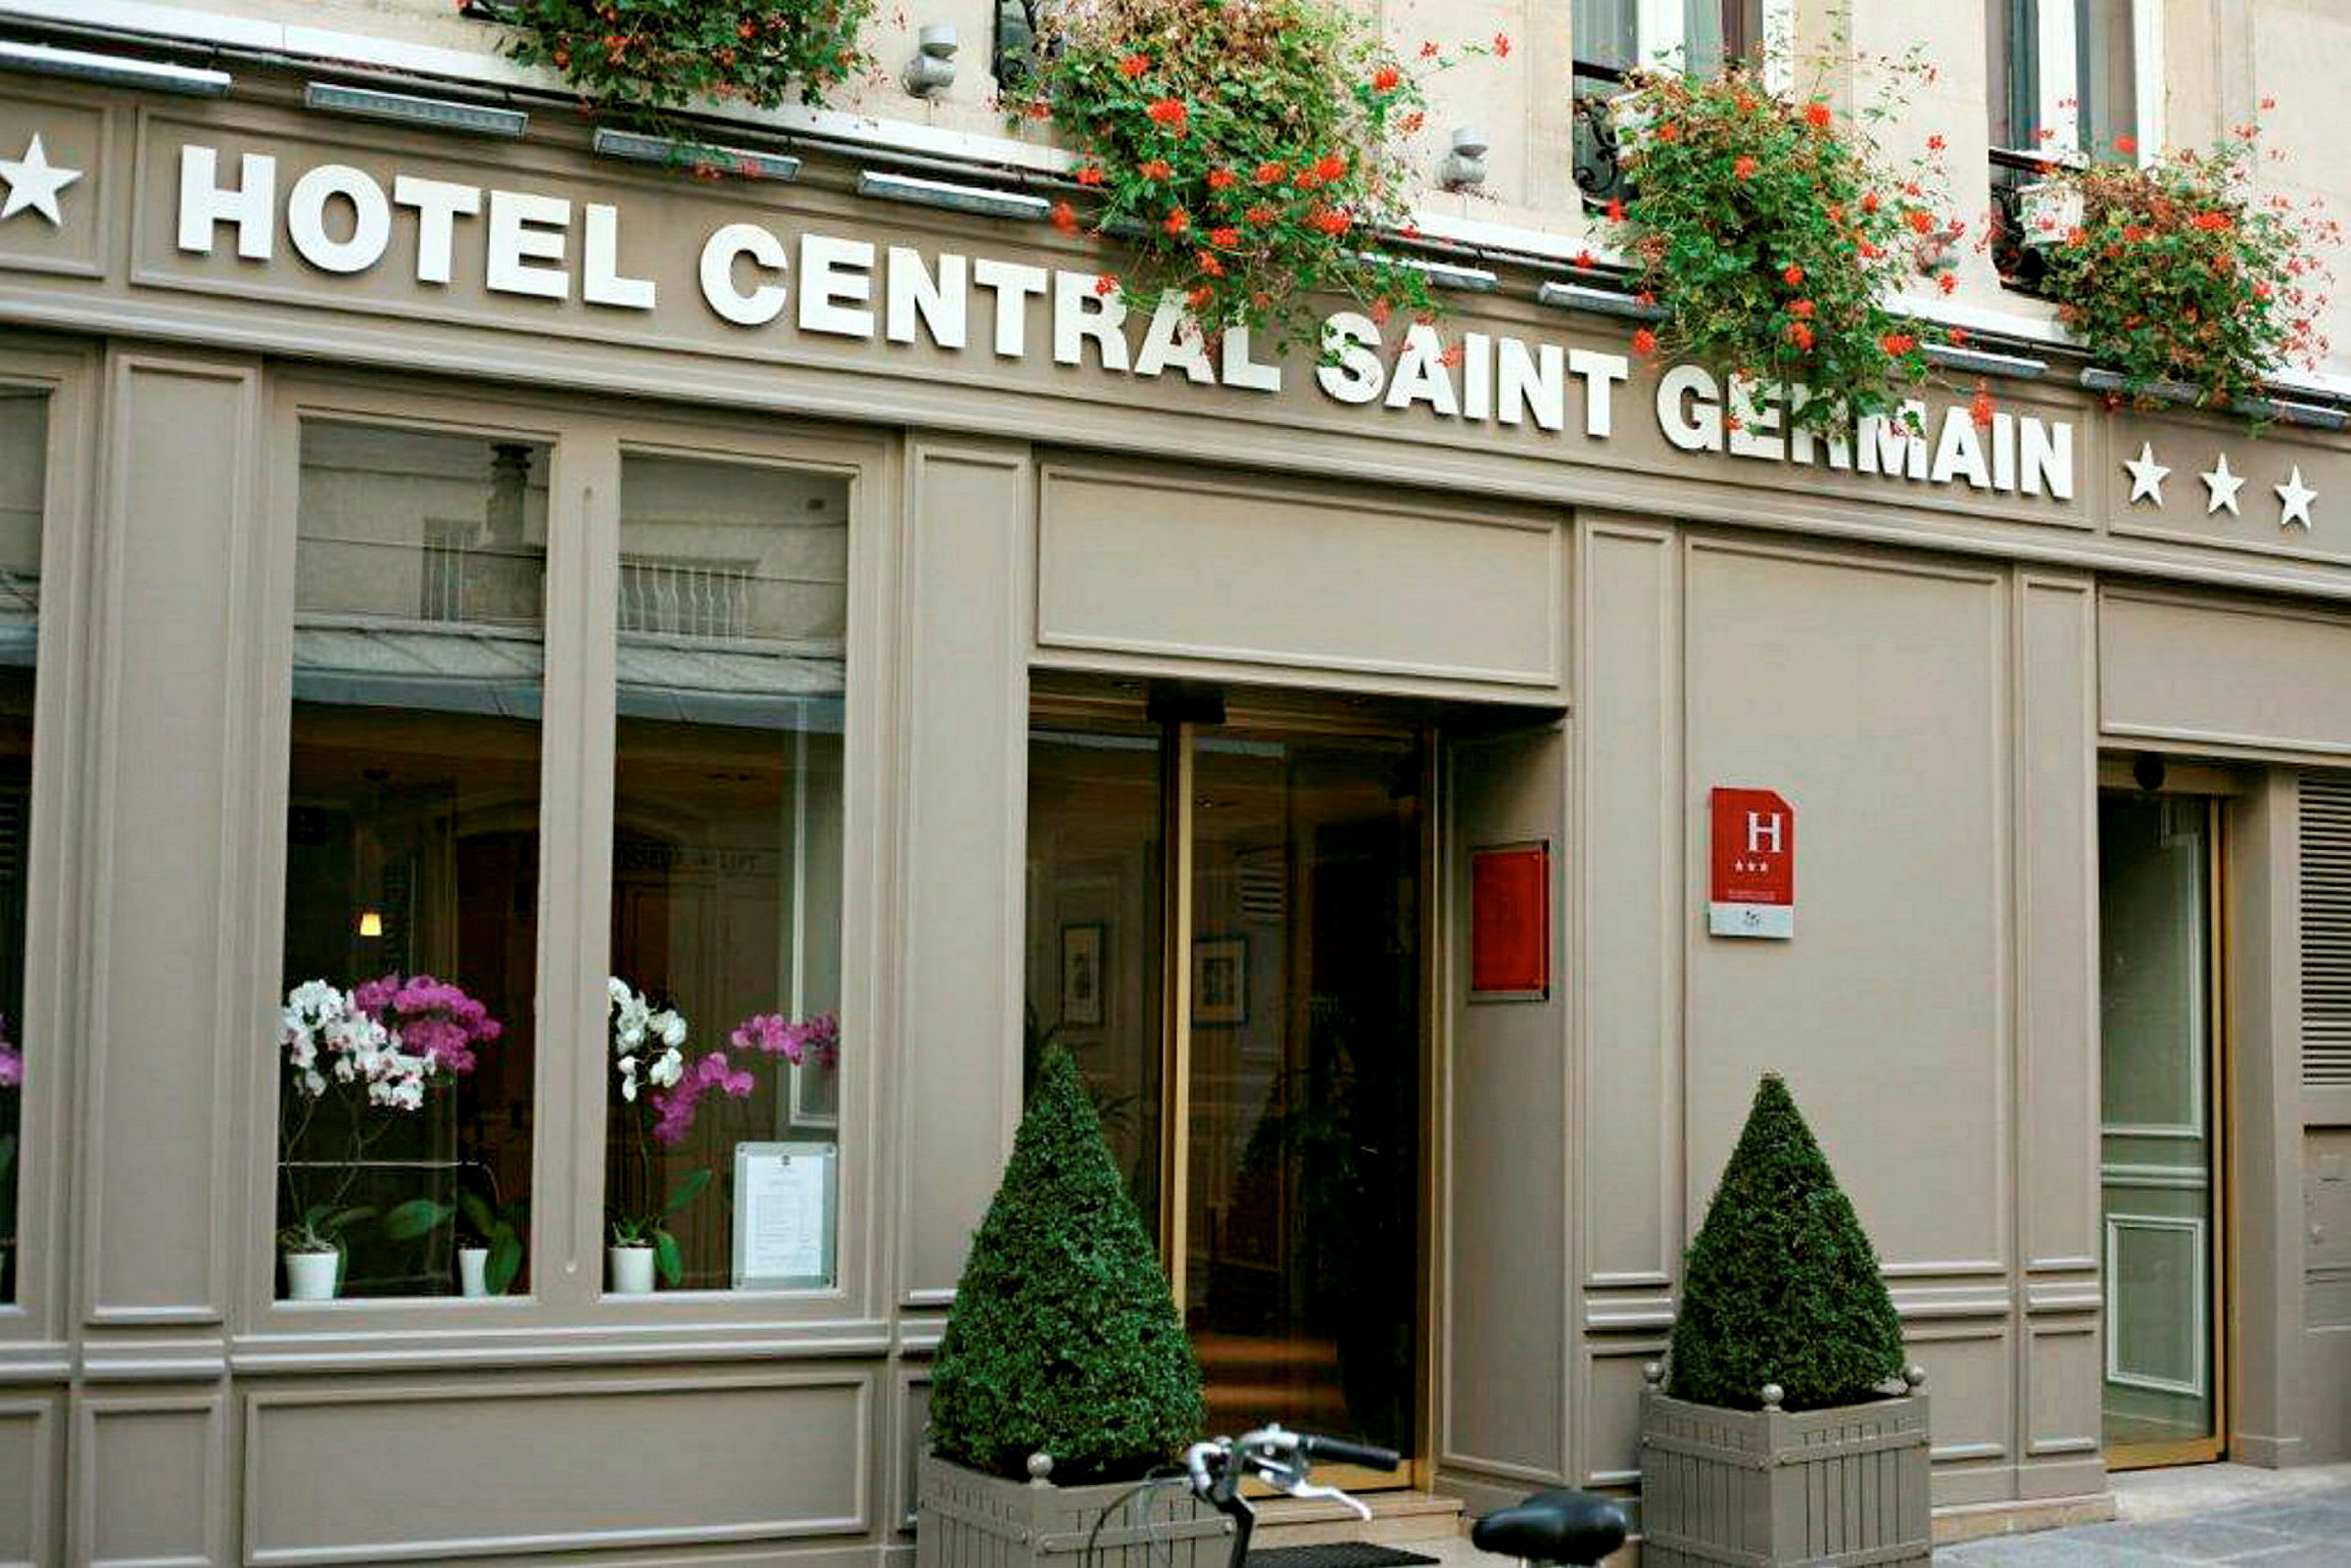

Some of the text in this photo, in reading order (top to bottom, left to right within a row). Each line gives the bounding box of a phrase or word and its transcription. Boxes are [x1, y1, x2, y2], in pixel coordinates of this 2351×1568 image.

[178, 145, 656, 309] HOTEL
[700, 223, 1281, 392] CENTRAL
[1316, 311, 1629, 437] SAINT
[1748, 812, 1782, 852] H
